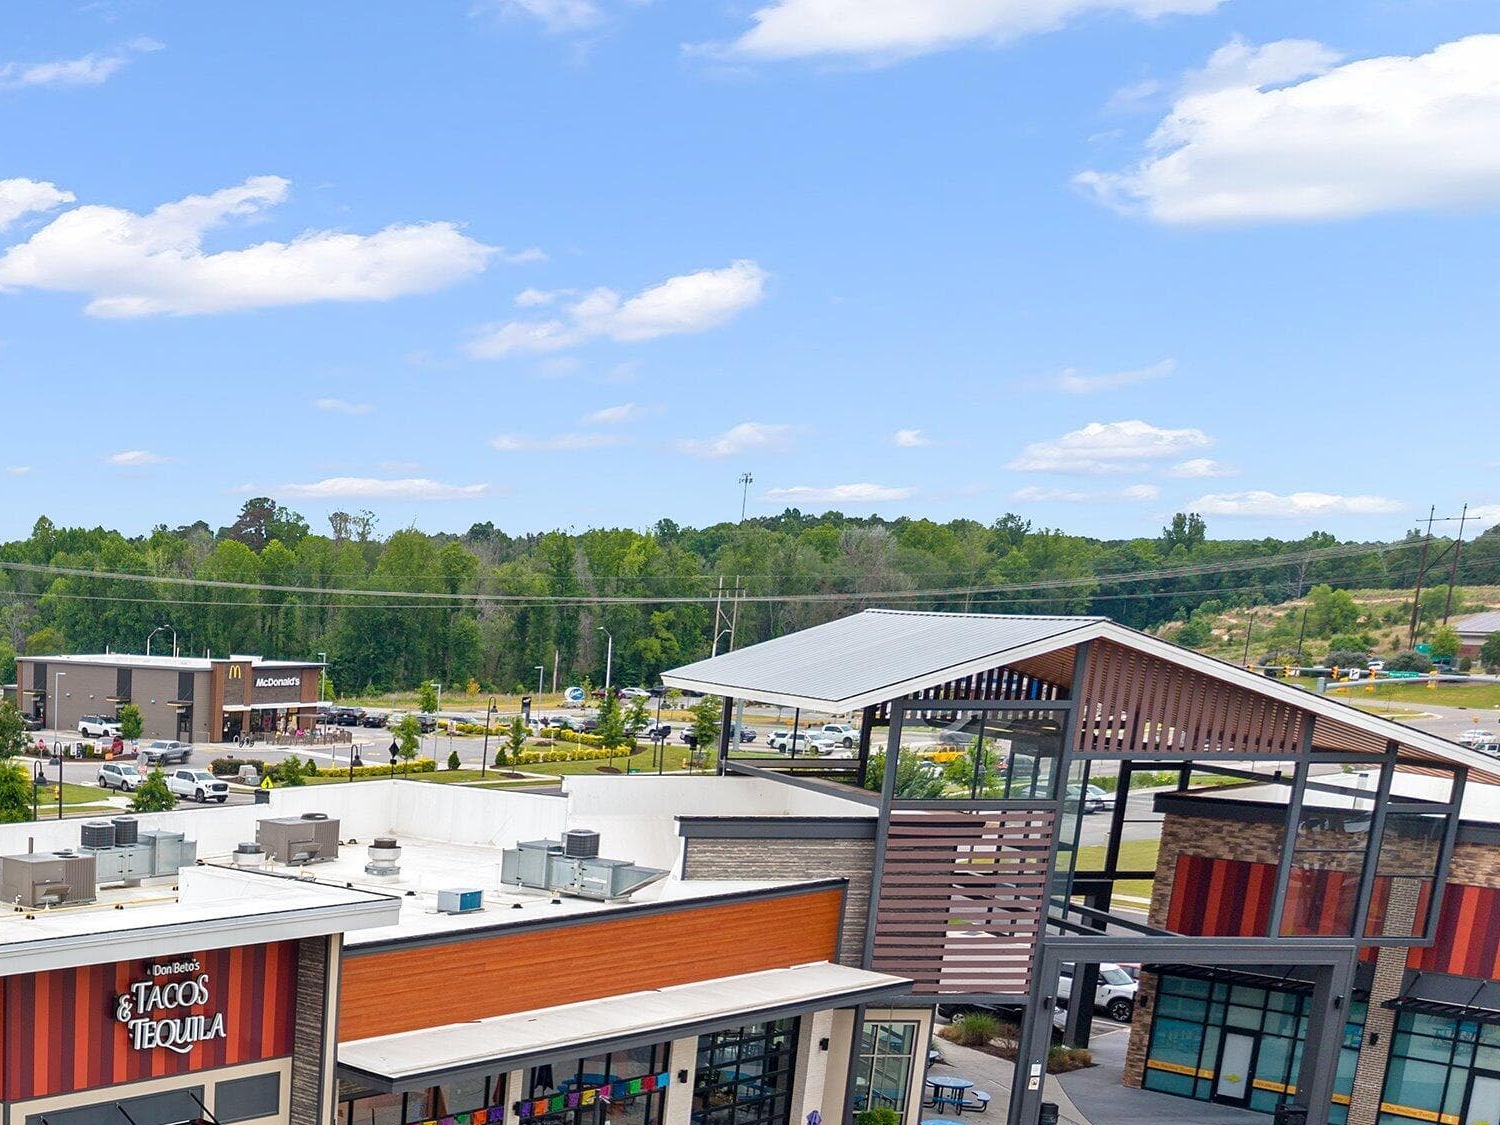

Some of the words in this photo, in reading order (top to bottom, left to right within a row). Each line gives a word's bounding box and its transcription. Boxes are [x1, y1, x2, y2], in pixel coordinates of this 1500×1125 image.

[256, 677, 300, 687] McDonald's
[153, 964, 172, 976] Don
[173, 959, 200, 973] Beto's
[131, 974, 209, 1014] TACOS
[116, 994, 133, 1022] &
[128, 1012, 227, 1053] TEQUILA
